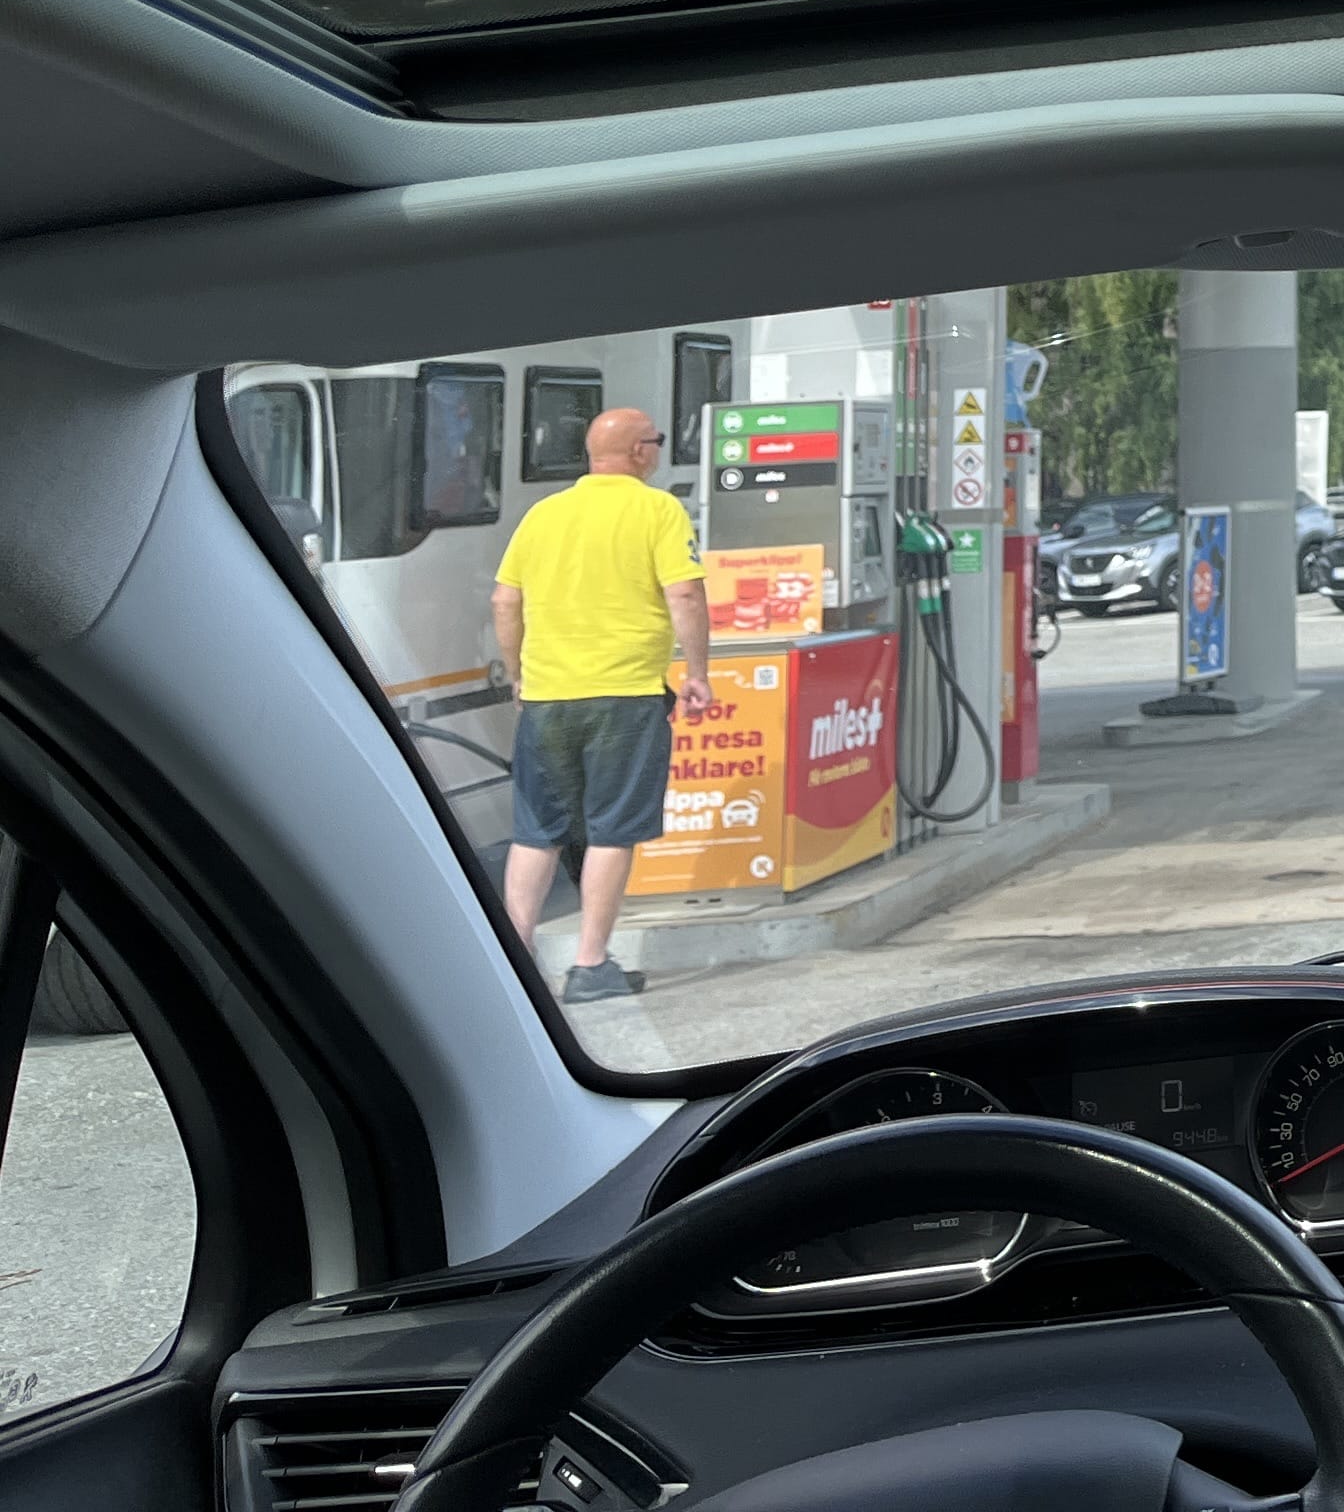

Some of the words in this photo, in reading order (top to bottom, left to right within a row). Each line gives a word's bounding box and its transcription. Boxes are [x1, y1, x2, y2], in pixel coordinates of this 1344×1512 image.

[701, 730, 763, 751] resa
[670, 755, 765, 781] nklare!
[1326, 1051, 1344, 1068] 90
[1302, 1068, 1320, 1088] 70
[932, 1092, 943, 1105] 3
[1286, 1092, 1303, 1113] 50
[1280, 1122, 1293, 1142] 30
[1281, 1152, 1295, 1169] 10
